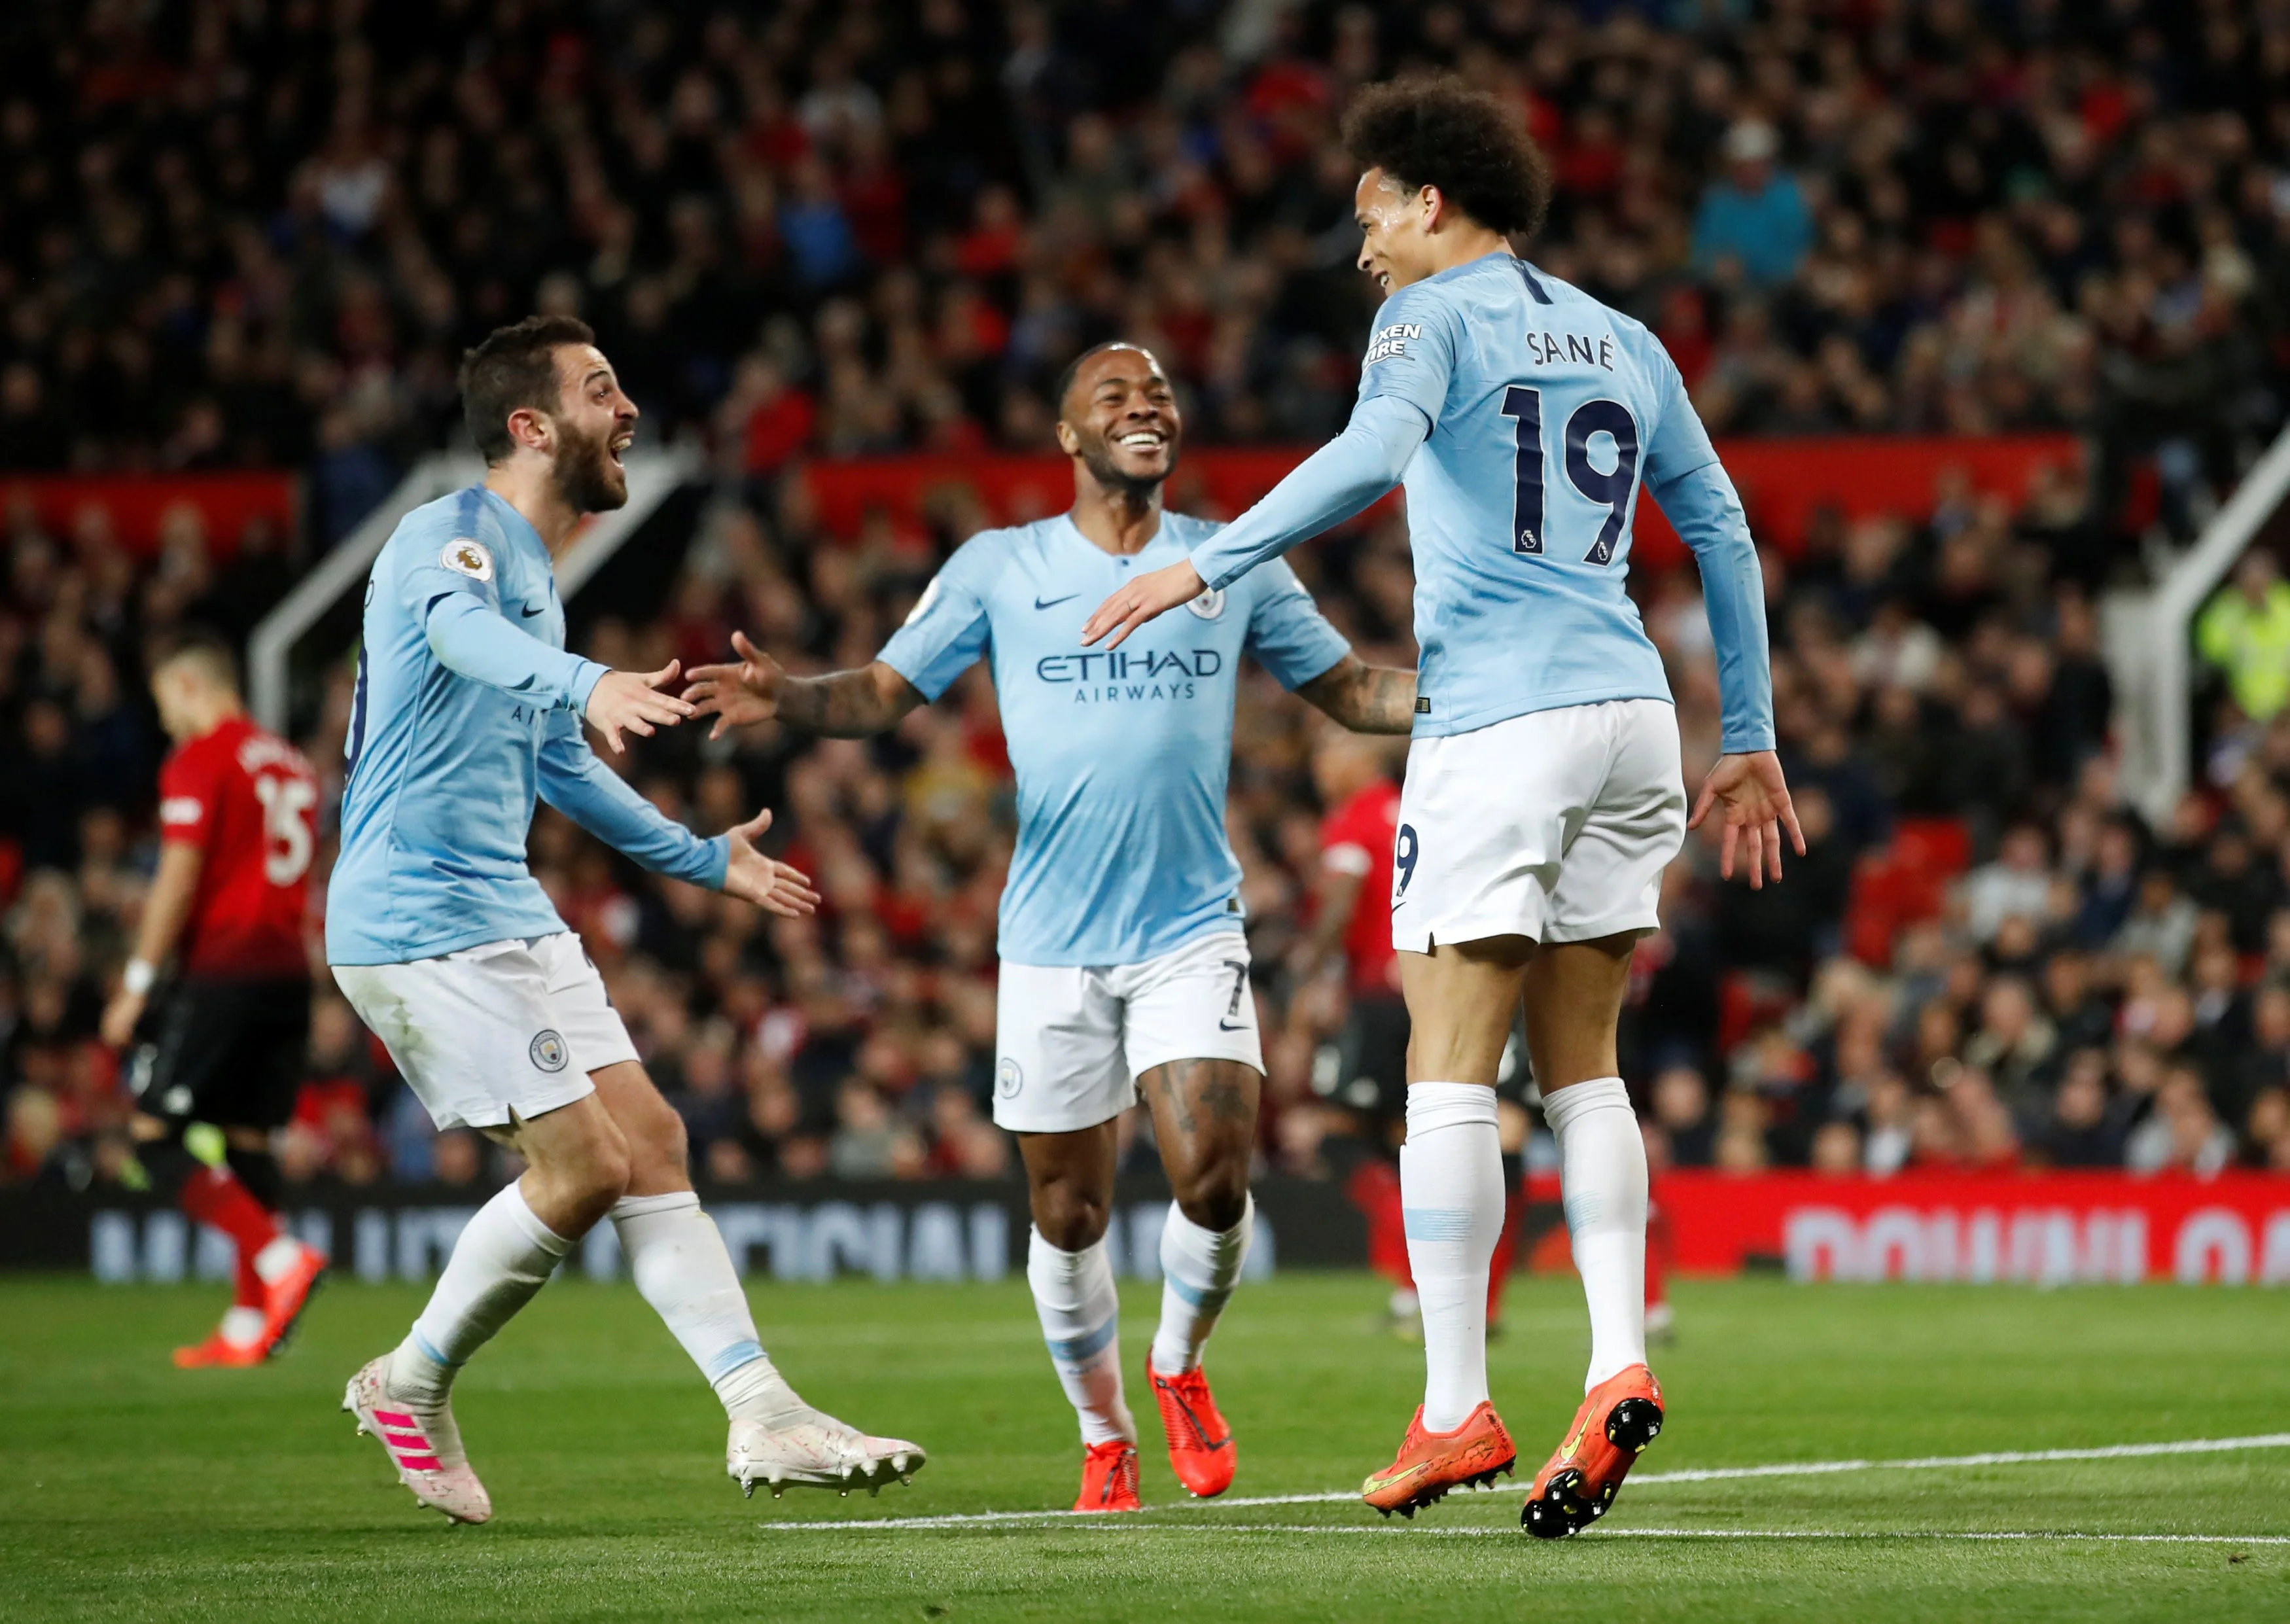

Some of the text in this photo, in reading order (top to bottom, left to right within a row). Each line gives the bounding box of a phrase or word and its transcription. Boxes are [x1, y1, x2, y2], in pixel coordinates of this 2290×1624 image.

[1368, 324, 1422, 351] EXEN
[1526, 332, 1615, 373] SANÉ
[1500, 385, 1639, 567] 19
[1036, 650, 1222, 682] ETIHAD
[1074, 684, 1195, 704] AIRWAYS
[1224, 961, 1246, 1017] 7
